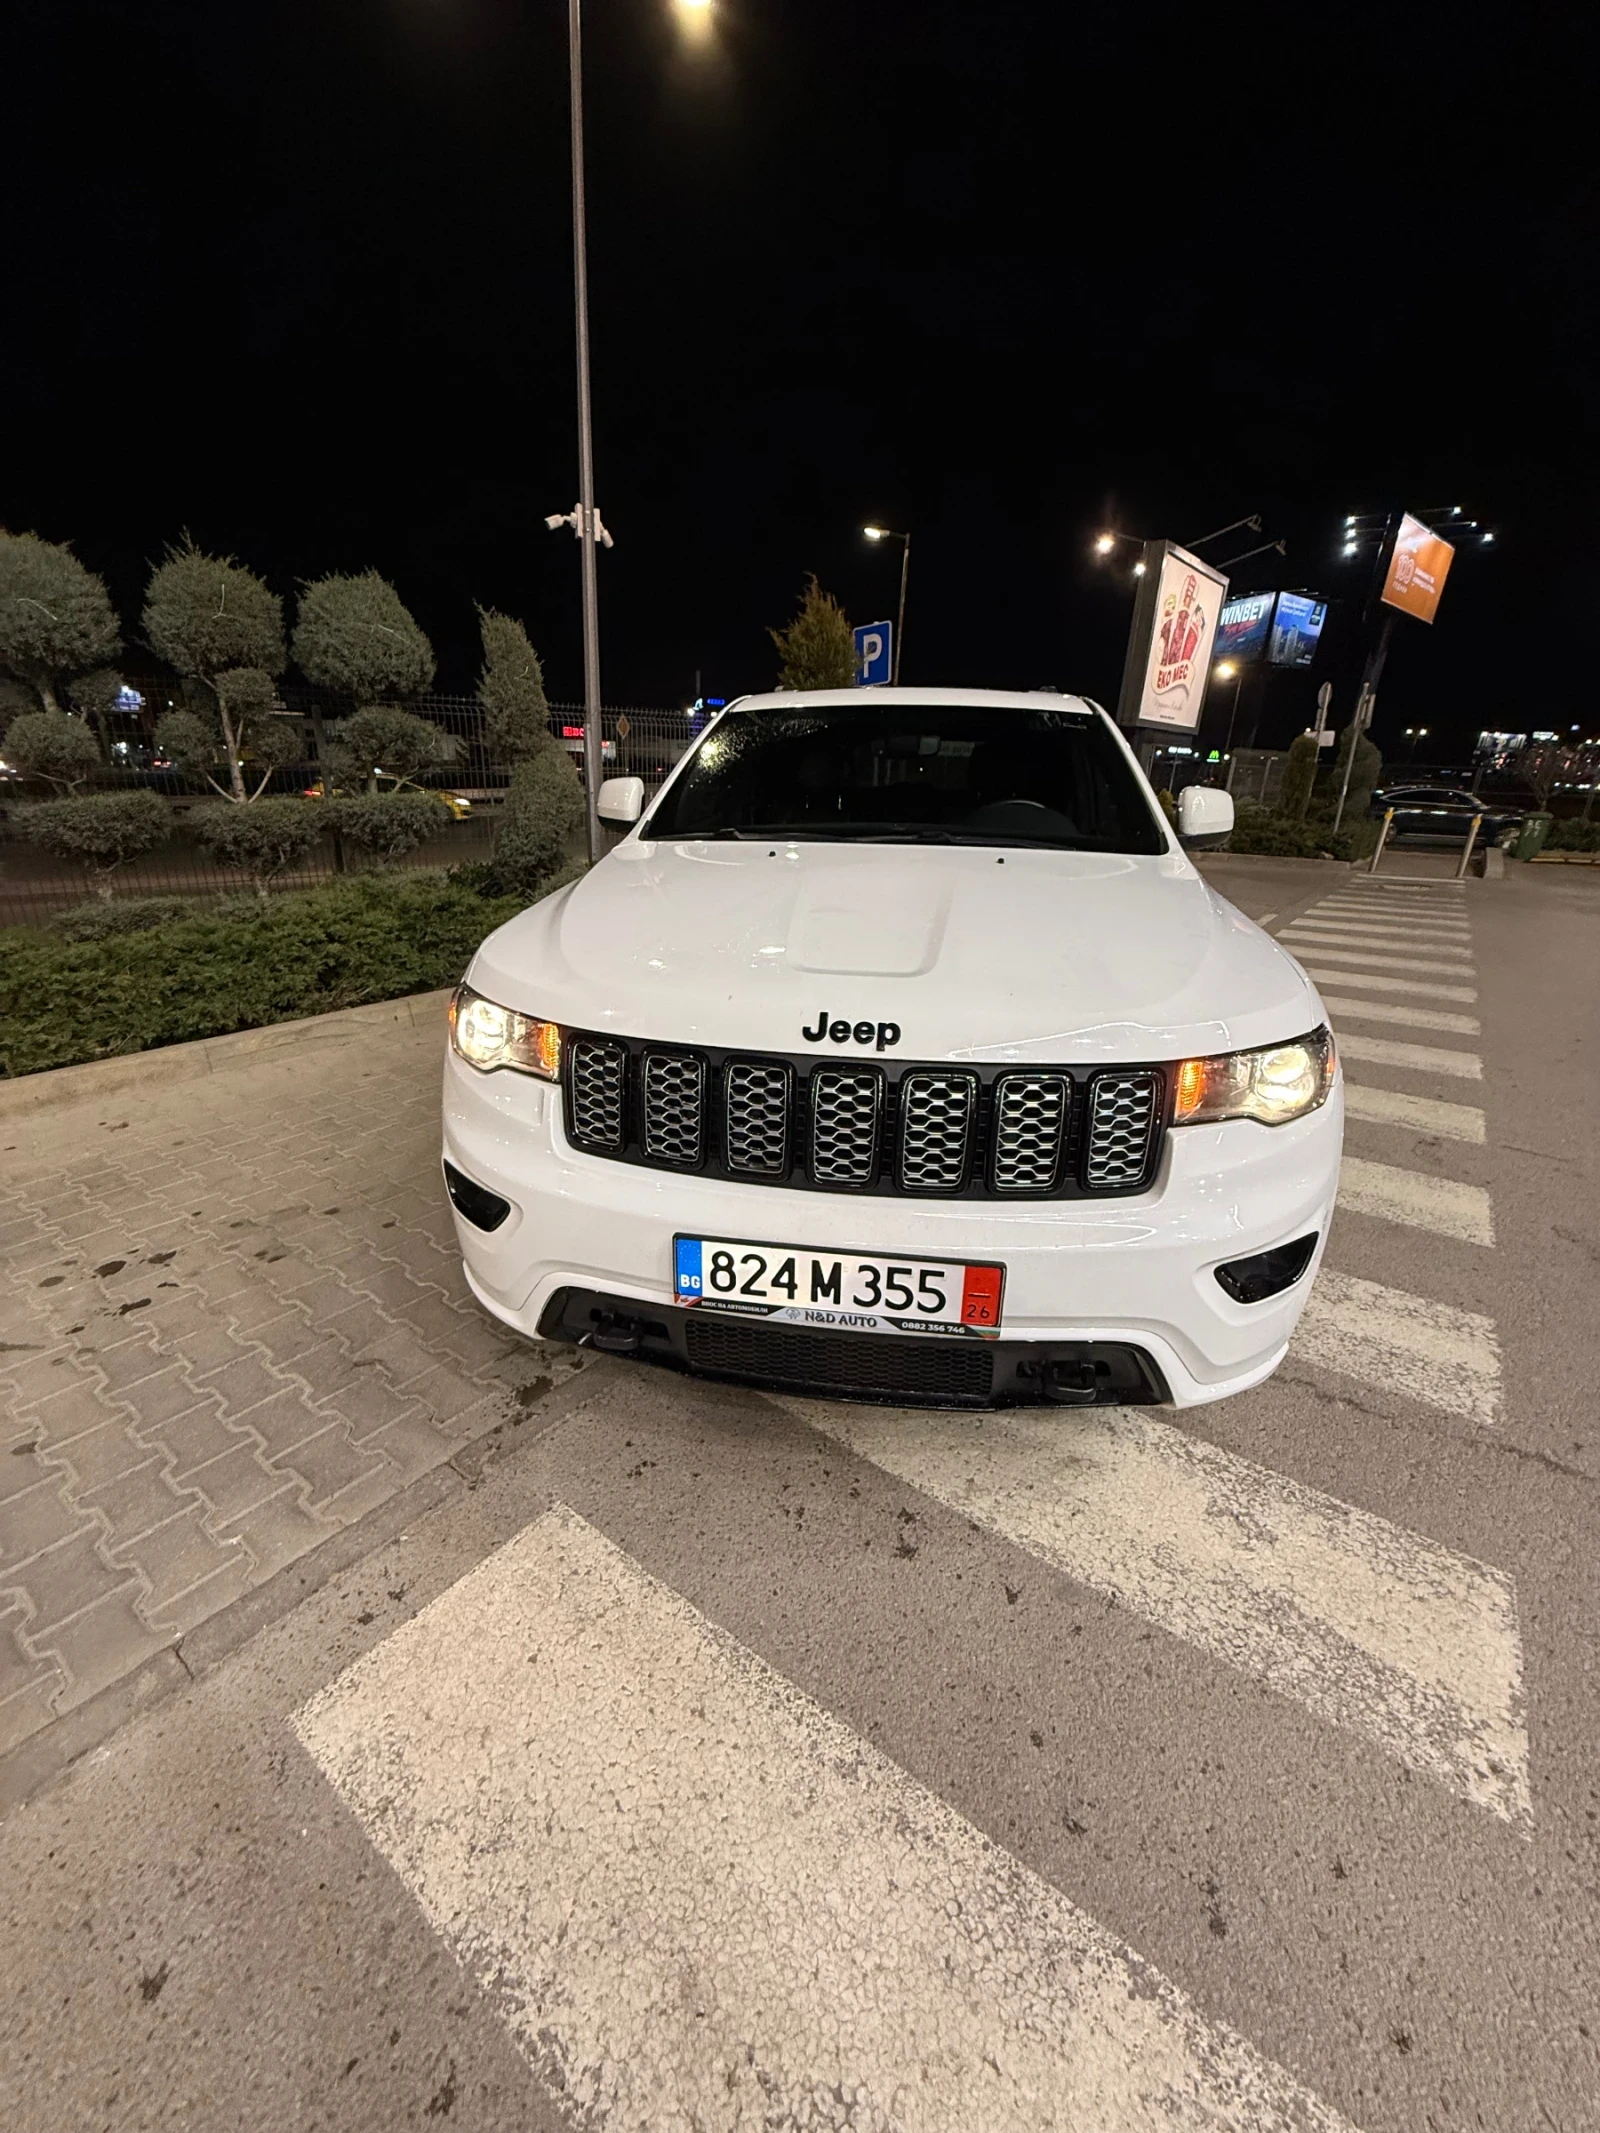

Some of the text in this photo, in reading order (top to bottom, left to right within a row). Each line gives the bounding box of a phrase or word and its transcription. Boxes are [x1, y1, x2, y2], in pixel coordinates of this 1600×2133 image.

[1220, 601, 1267, 626] WINBET
[863, 633, 883, 679] P
[802, 1011, 901, 1052] Jeep
[680, 1274, 701, 1290] BG
[709, 1250, 946, 1313] 824 M 355
[804, 1310, 877, 1328] N&D AUTO
[967, 1304, 990, 1319] 26
[901, 1321, 965, 1334] 0882 356 746
